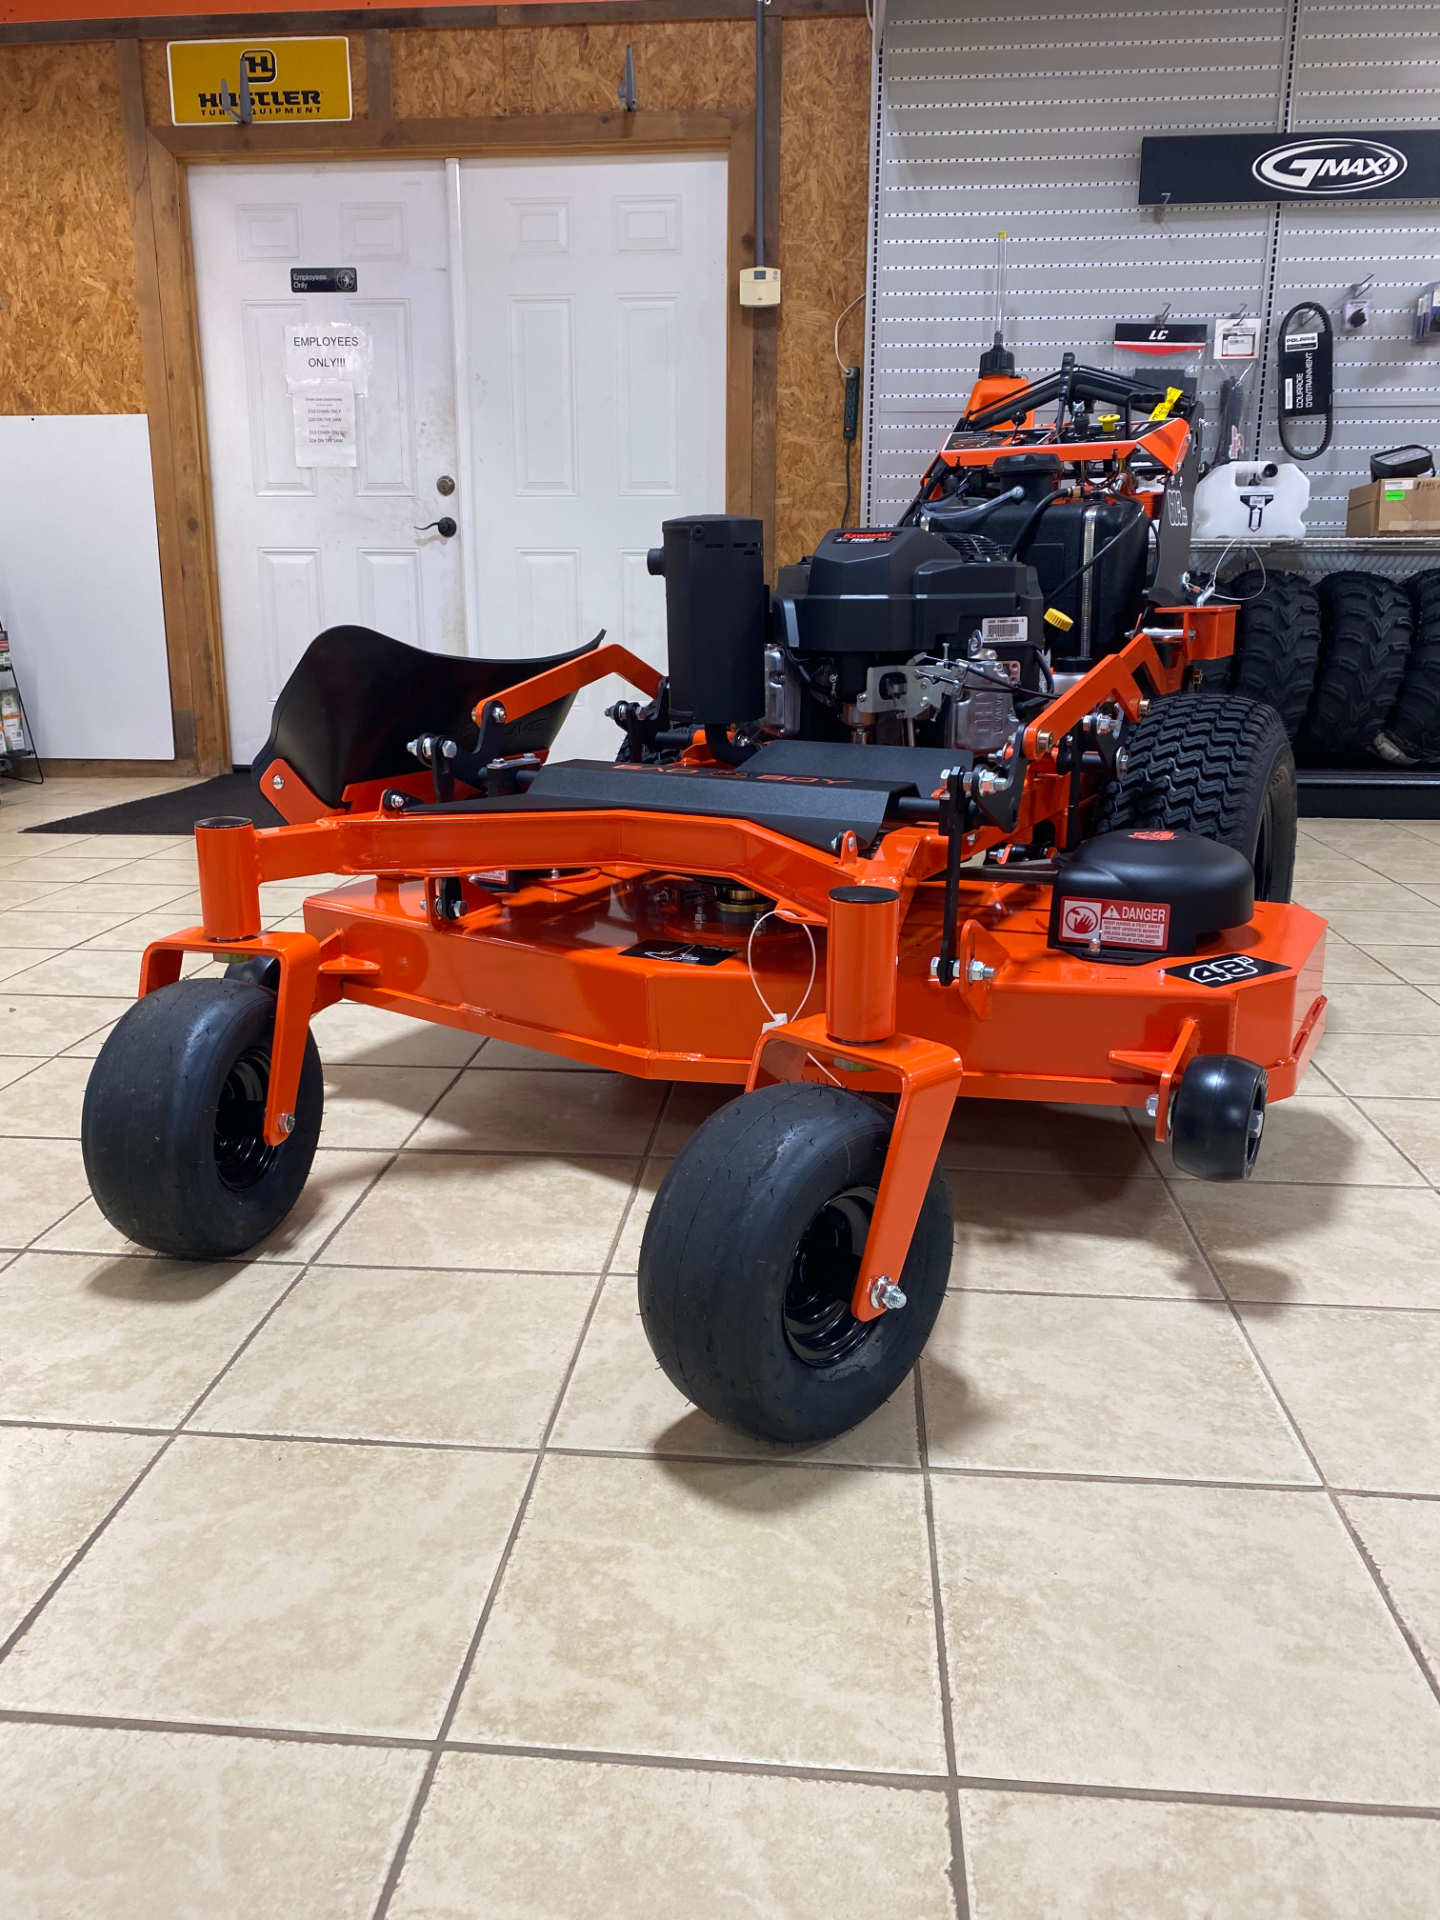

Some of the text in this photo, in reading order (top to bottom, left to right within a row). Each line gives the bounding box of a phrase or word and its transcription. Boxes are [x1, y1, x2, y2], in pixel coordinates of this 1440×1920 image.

[247, 107, 321, 115] QUIPMENT
[1261, 143, 1394, 188] GMAX
[293, 273, 327, 281] Employees
[293, 281, 308, 289] Only
[1148, 329, 1169, 340] LC
[1286, 335, 1316, 343] POLARIS
[293, 336, 359, 347] EMPLOYEES
[308, 357, 346, 368] ONLY!!!
[1296, 372, 1304, 409] COURROIE
[756, 774, 855, 785] BOY
[1122, 906, 1166, 922] DANGER
